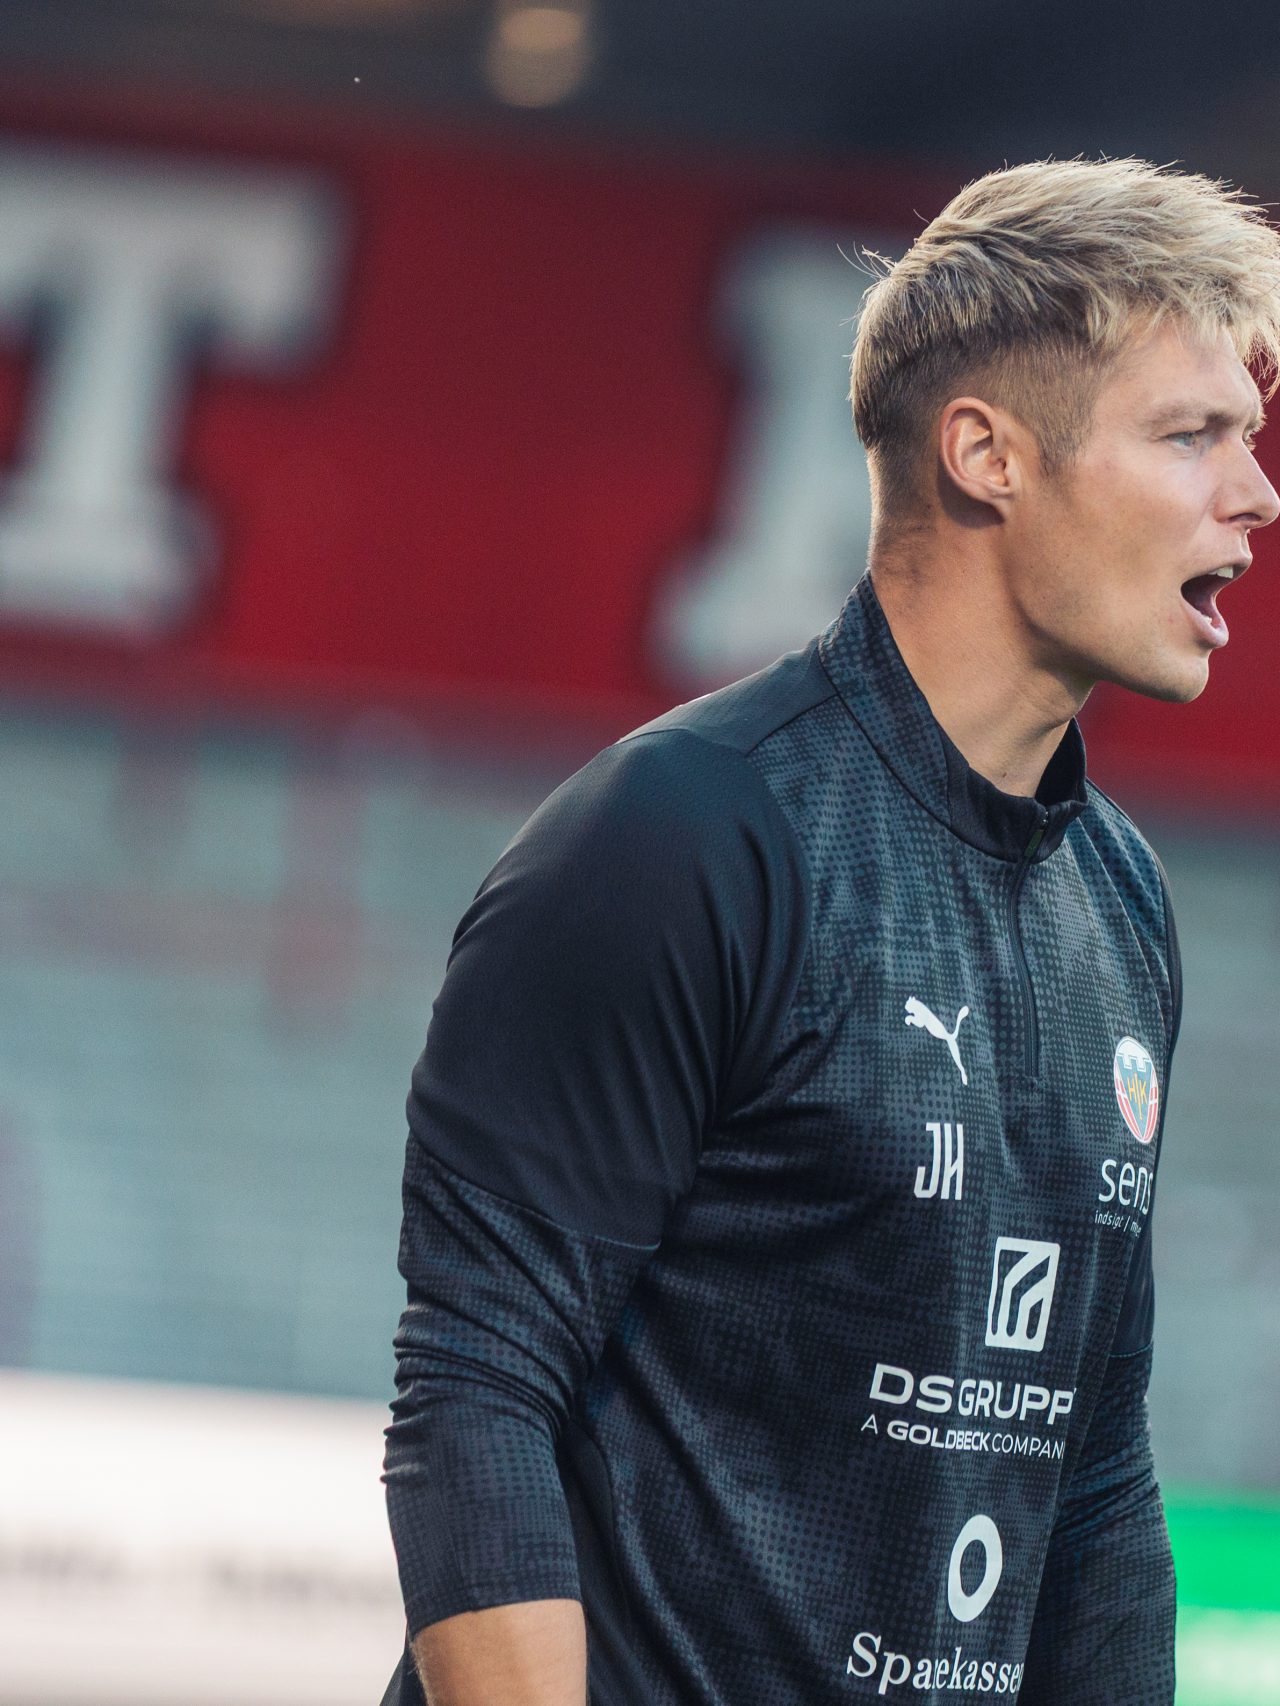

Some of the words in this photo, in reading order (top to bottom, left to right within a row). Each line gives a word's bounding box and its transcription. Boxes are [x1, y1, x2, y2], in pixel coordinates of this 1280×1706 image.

[913, 1122, 964, 1201] JH
[1094, 1210, 1124, 1230] indsigt
[957, 1378, 1077, 1425] GRUPP
[860, 1413, 879, 1435] A
[991, 1433, 1066, 1460] COMPAN
